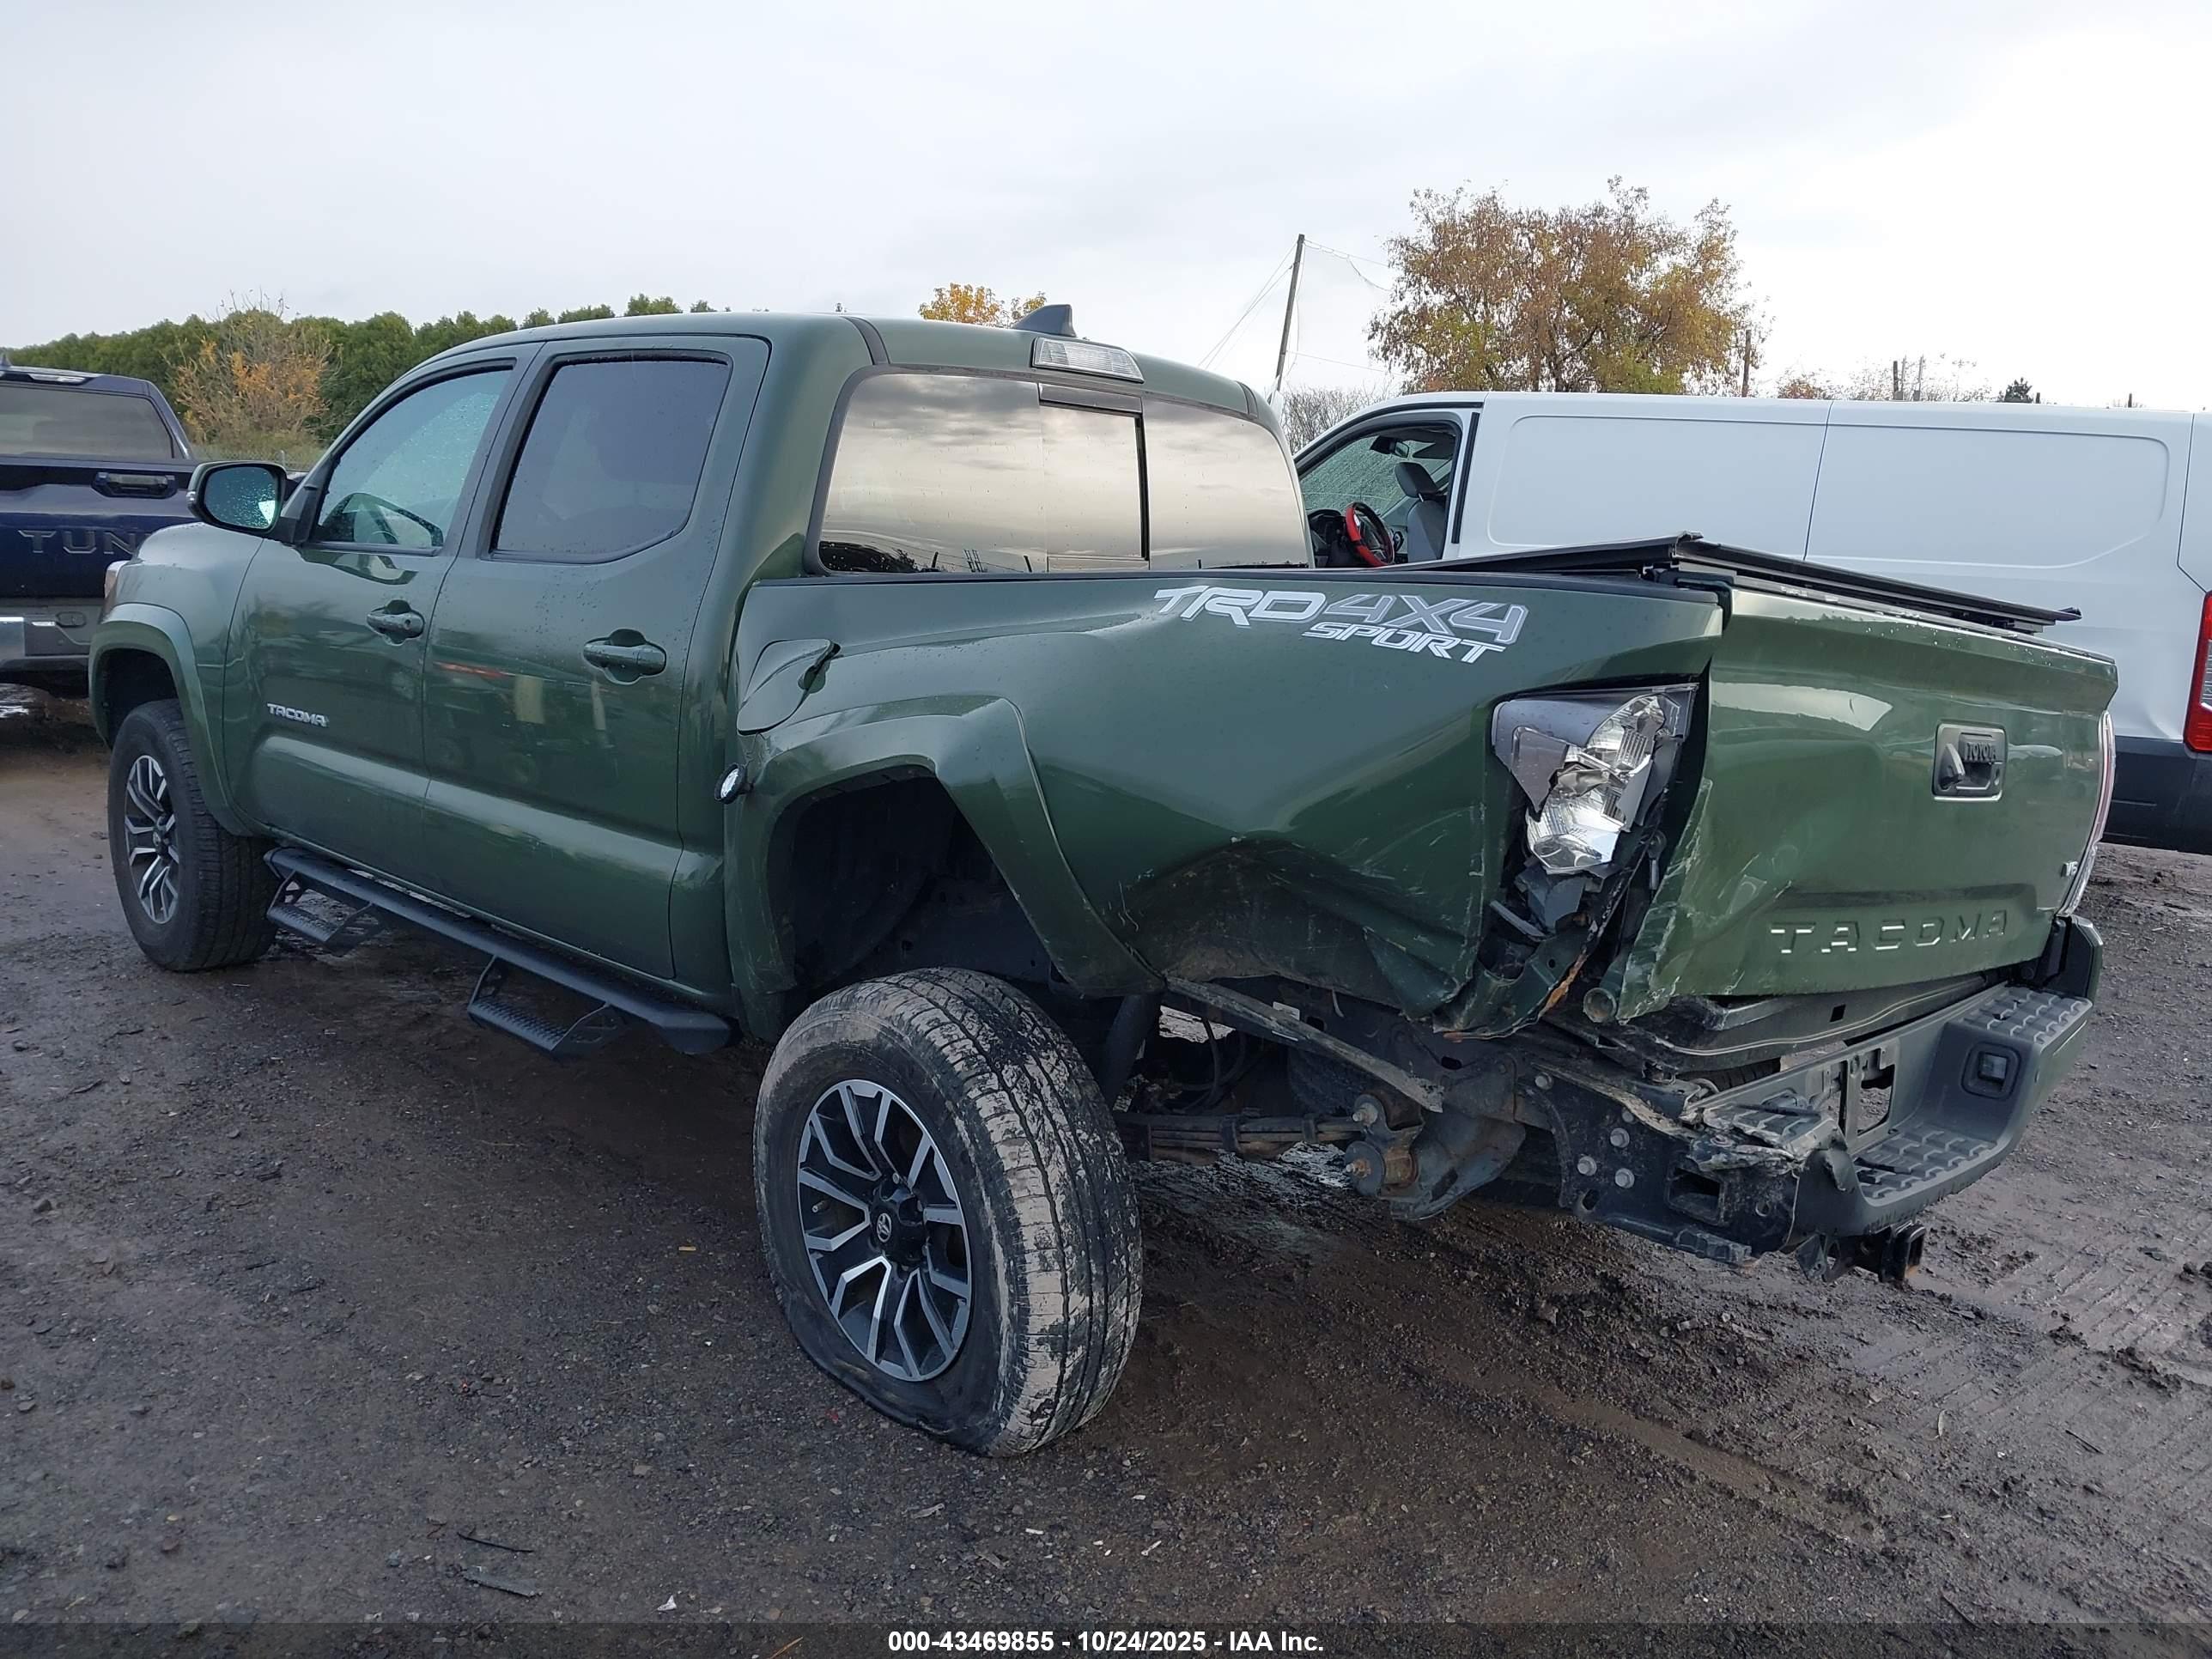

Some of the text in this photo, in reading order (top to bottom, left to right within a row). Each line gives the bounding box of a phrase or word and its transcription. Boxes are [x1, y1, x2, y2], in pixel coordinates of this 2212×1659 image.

[18, 529, 149, 556] TUN
[1153, 585, 1529, 644] TRD 4X4
[1301, 621, 1507, 664] SPORT
[266, 702, 328, 727] TACOMA
[1769, 908, 2008, 954] TACOMA
